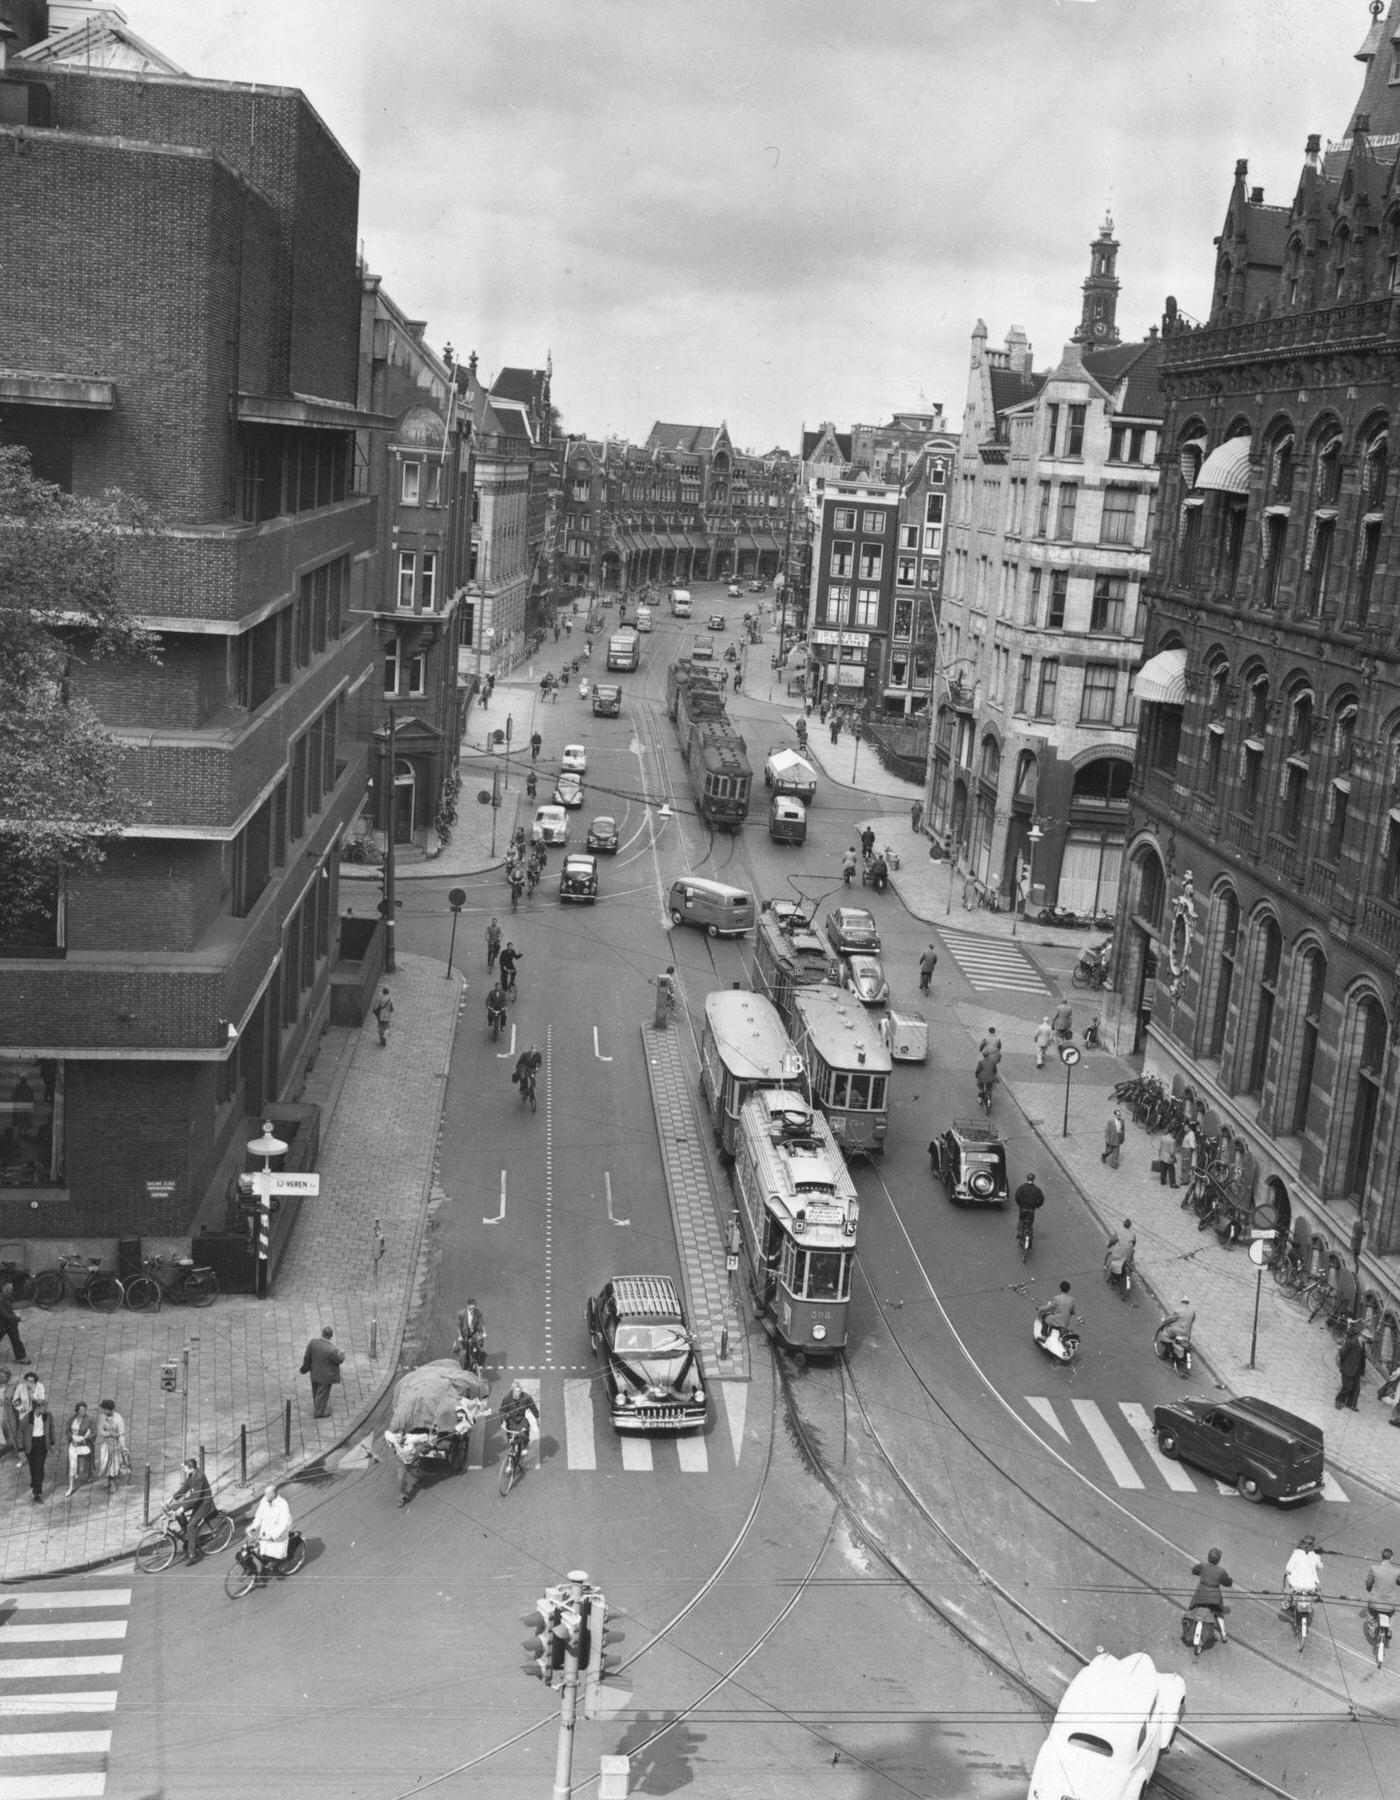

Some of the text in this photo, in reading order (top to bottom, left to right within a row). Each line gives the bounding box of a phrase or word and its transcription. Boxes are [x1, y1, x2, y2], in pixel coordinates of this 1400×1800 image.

[786, 1054, 803, 1073] 13
[845, 1223, 857, 1234] 13
[729, 1256, 737, 1266] H
